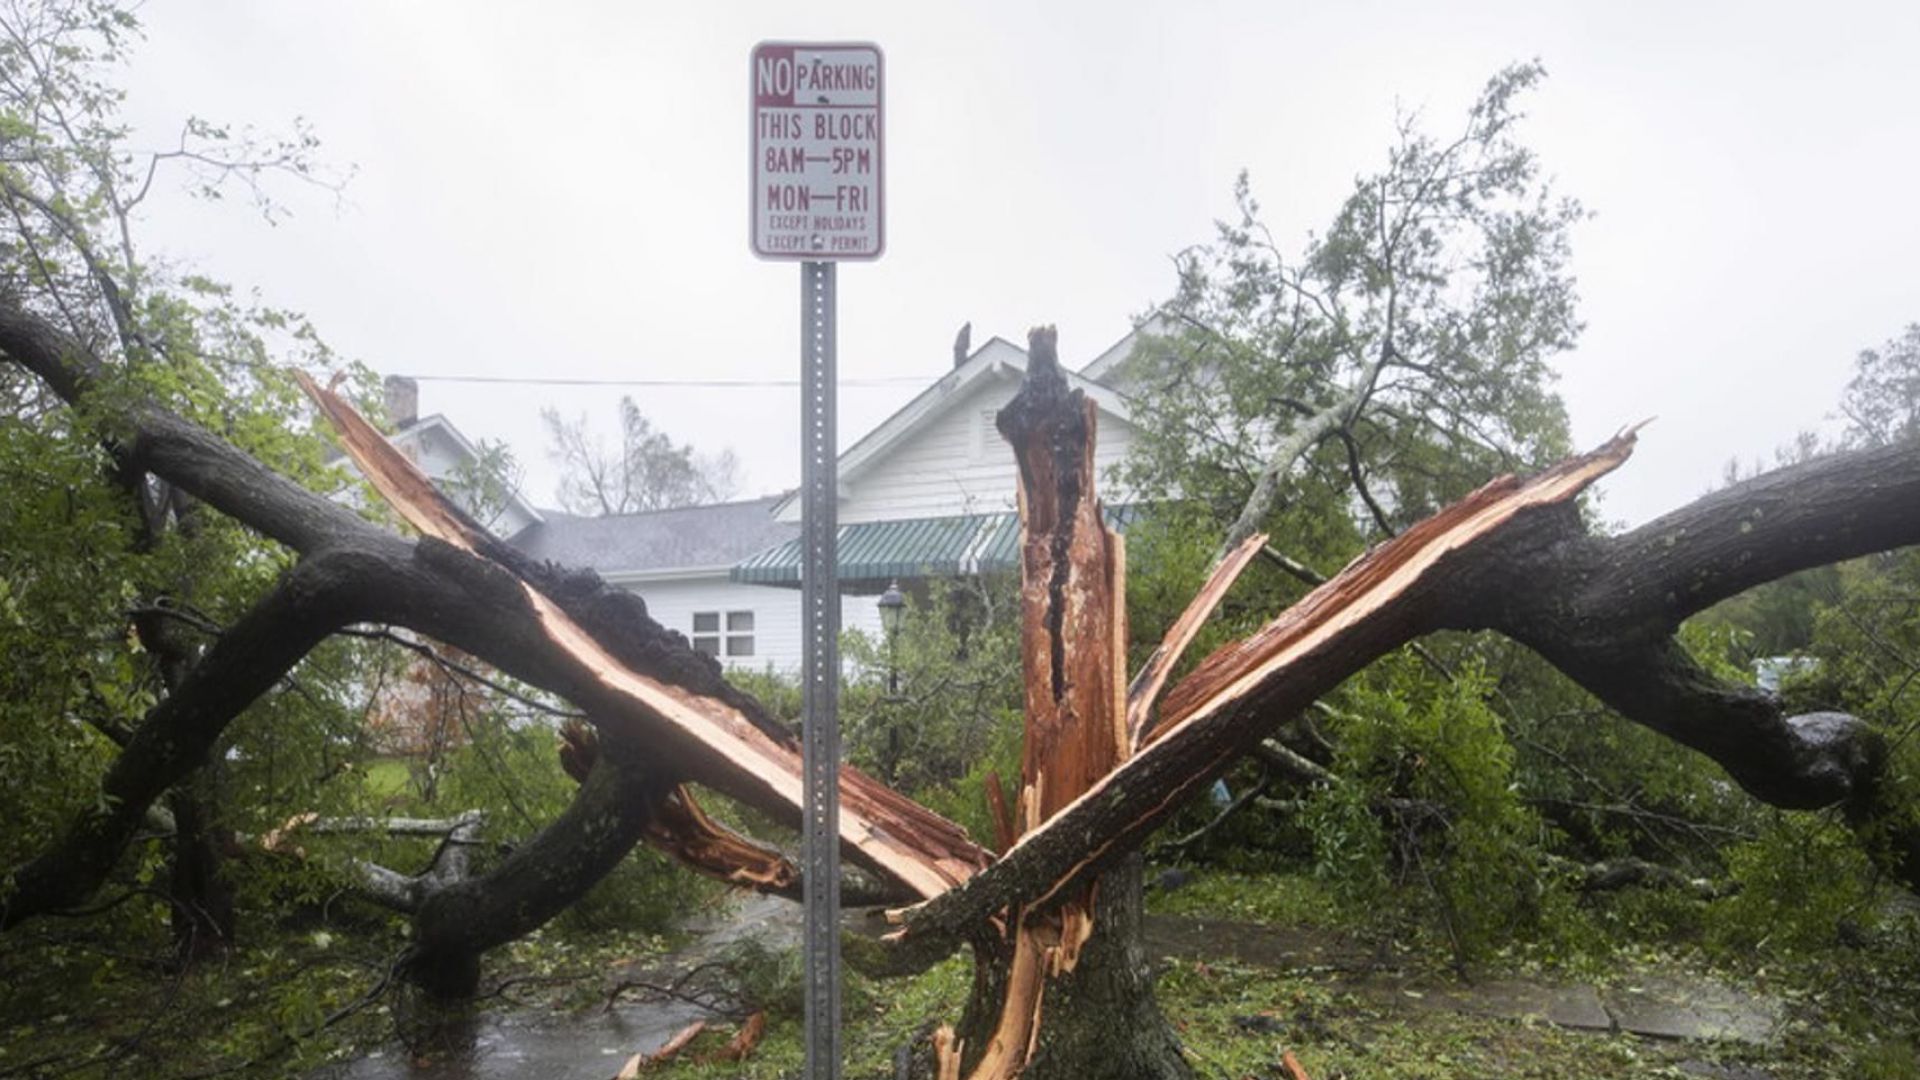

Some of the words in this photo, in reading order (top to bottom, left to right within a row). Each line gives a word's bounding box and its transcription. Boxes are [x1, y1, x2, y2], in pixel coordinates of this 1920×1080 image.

[758, 58, 792, 96] NO
[797, 64, 876, 90] PARKING
[760, 113, 801, 140] THIS
[815, 113, 876, 140] BLOCK
[769, 216, 808, 230] EXCEPT
[813, 216, 866, 231] HOLIDAYS
[767, 235, 805, 250] EXCEPT
[831, 236, 868, 250] PERMIT
